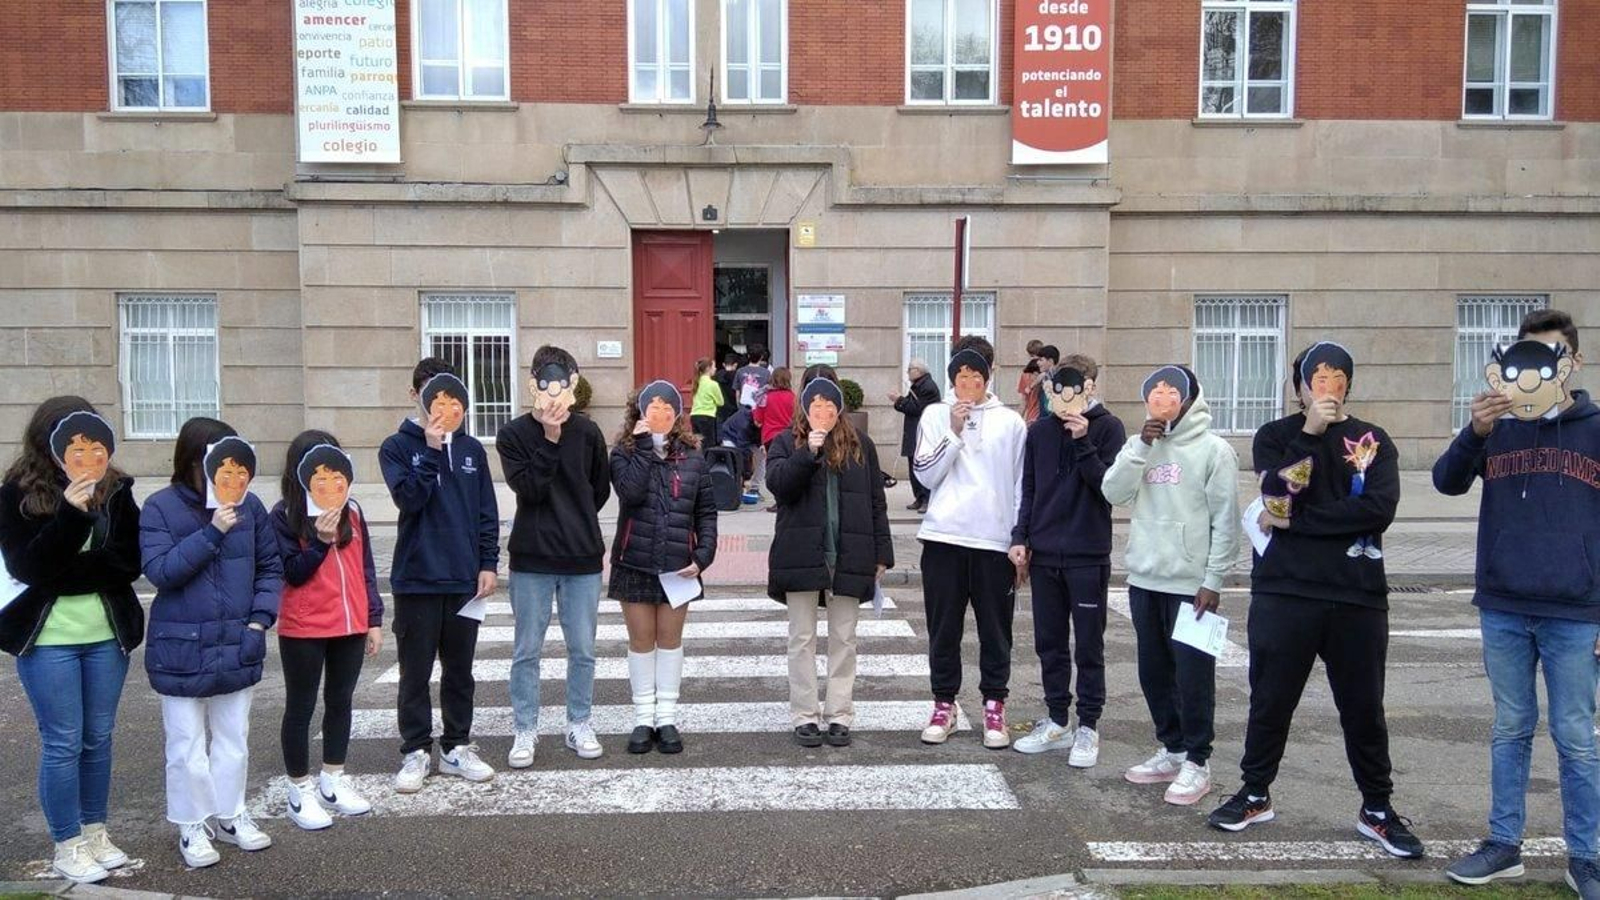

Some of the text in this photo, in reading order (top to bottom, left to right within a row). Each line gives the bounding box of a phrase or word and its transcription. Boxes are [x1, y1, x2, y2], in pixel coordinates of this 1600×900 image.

[1039, 0, 1089, 14] desde
[303, 15, 367, 26] amencer
[368, 23, 395, 31] cerca
[359, 36, 393, 49] patio
[1024, 24, 1102, 51] 1910
[350, 55, 393, 68] futuro
[302, 66, 345, 79] familia
[350, 72, 398, 84] parroq
[1022, 69, 1102, 83] potenciando
[305, 85, 338, 96] ANPA
[342, 90, 395, 101] confianza
[1055, 86, 1068, 98] el
[346, 105, 390, 116] calidad
[1020, 98, 1102, 119] talento
[323, 139, 378, 154] colegio
